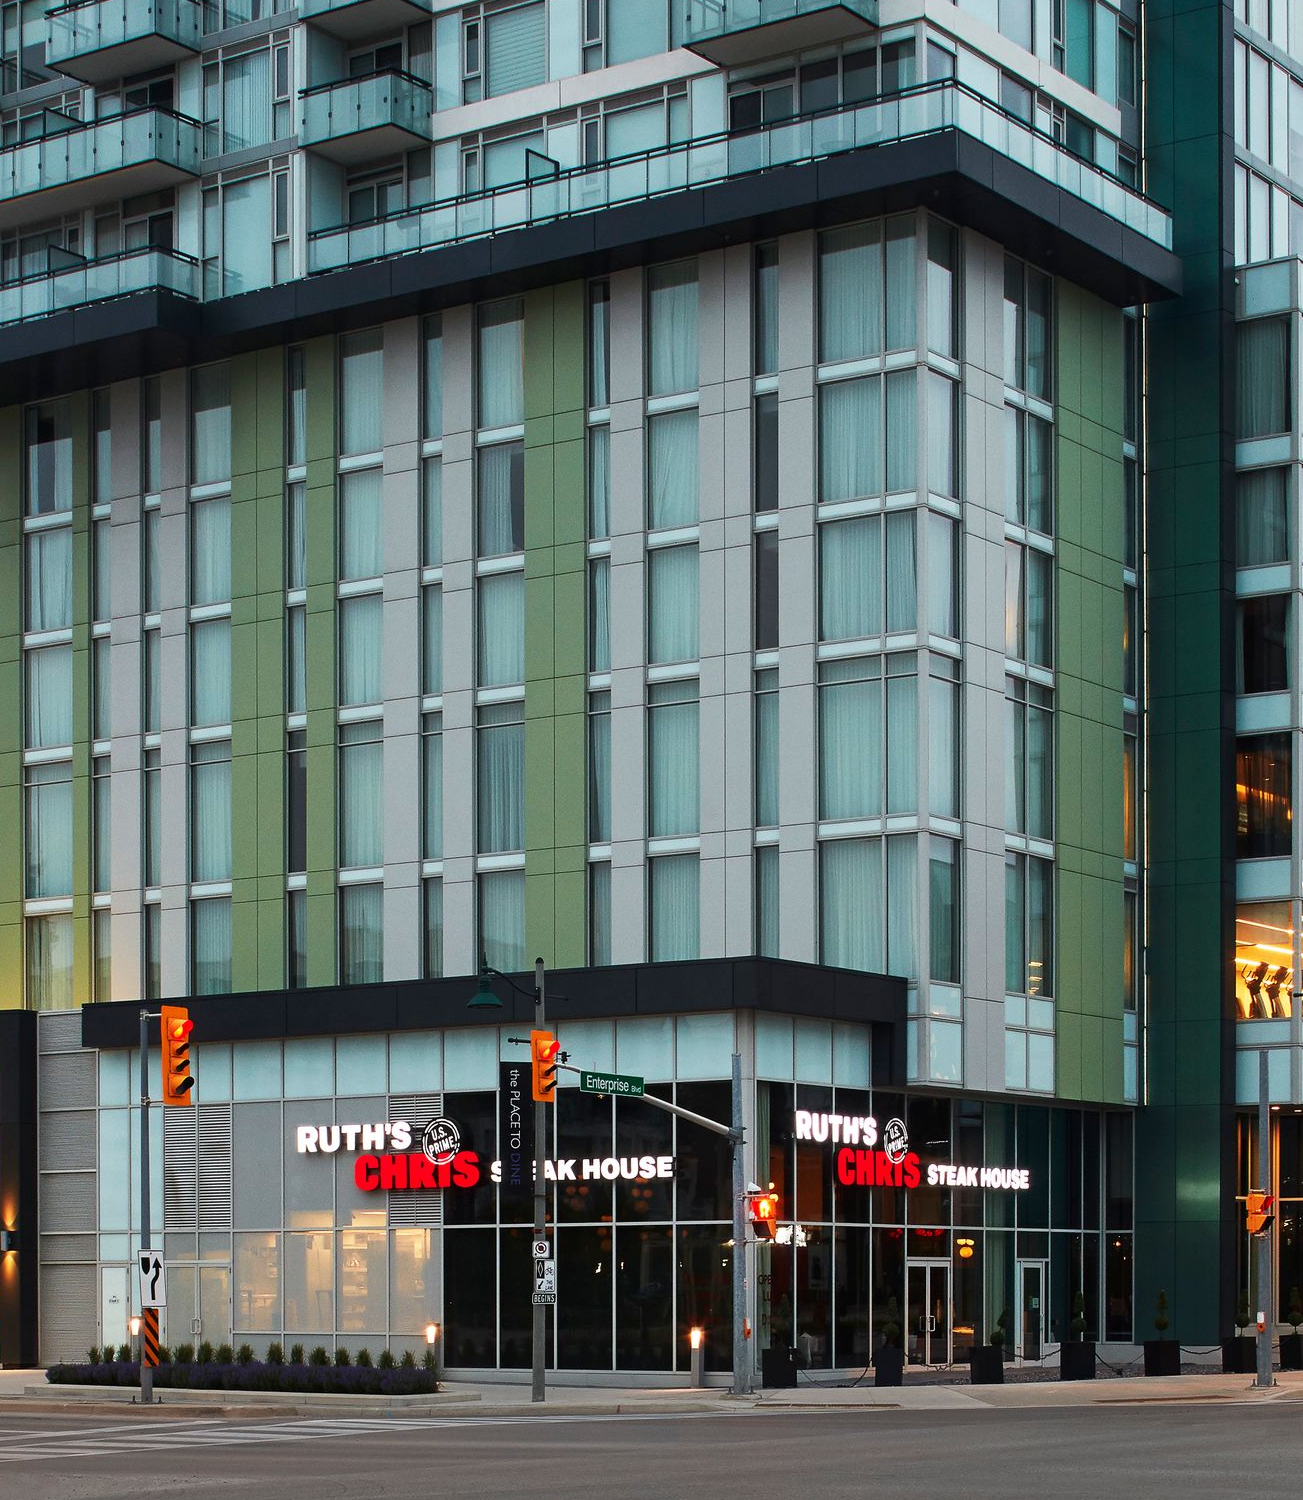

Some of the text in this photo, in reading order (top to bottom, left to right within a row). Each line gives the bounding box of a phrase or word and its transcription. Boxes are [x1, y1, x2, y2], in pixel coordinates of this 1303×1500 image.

[586, 1074, 642, 1094] Enterprise Blvd
[296, 1121, 413, 1154] RUTH'S
[431, 1126, 448, 1140] U.S.
[510, 1069, 521, 1186] the PLACE TO DINE
[795, 1110, 878, 1146] RUTH'S
[428, 1135, 456, 1157] PRIME
[354, 1151, 481, 1192] CHRIS
[490, 1156, 674, 1184] SAK HOUSE
[837, 1148, 921, 1189] CHRIS
[927, 1163, 1030, 1190] STEAK HOUSE
[534, 1294, 555, 1303] BEGINS
